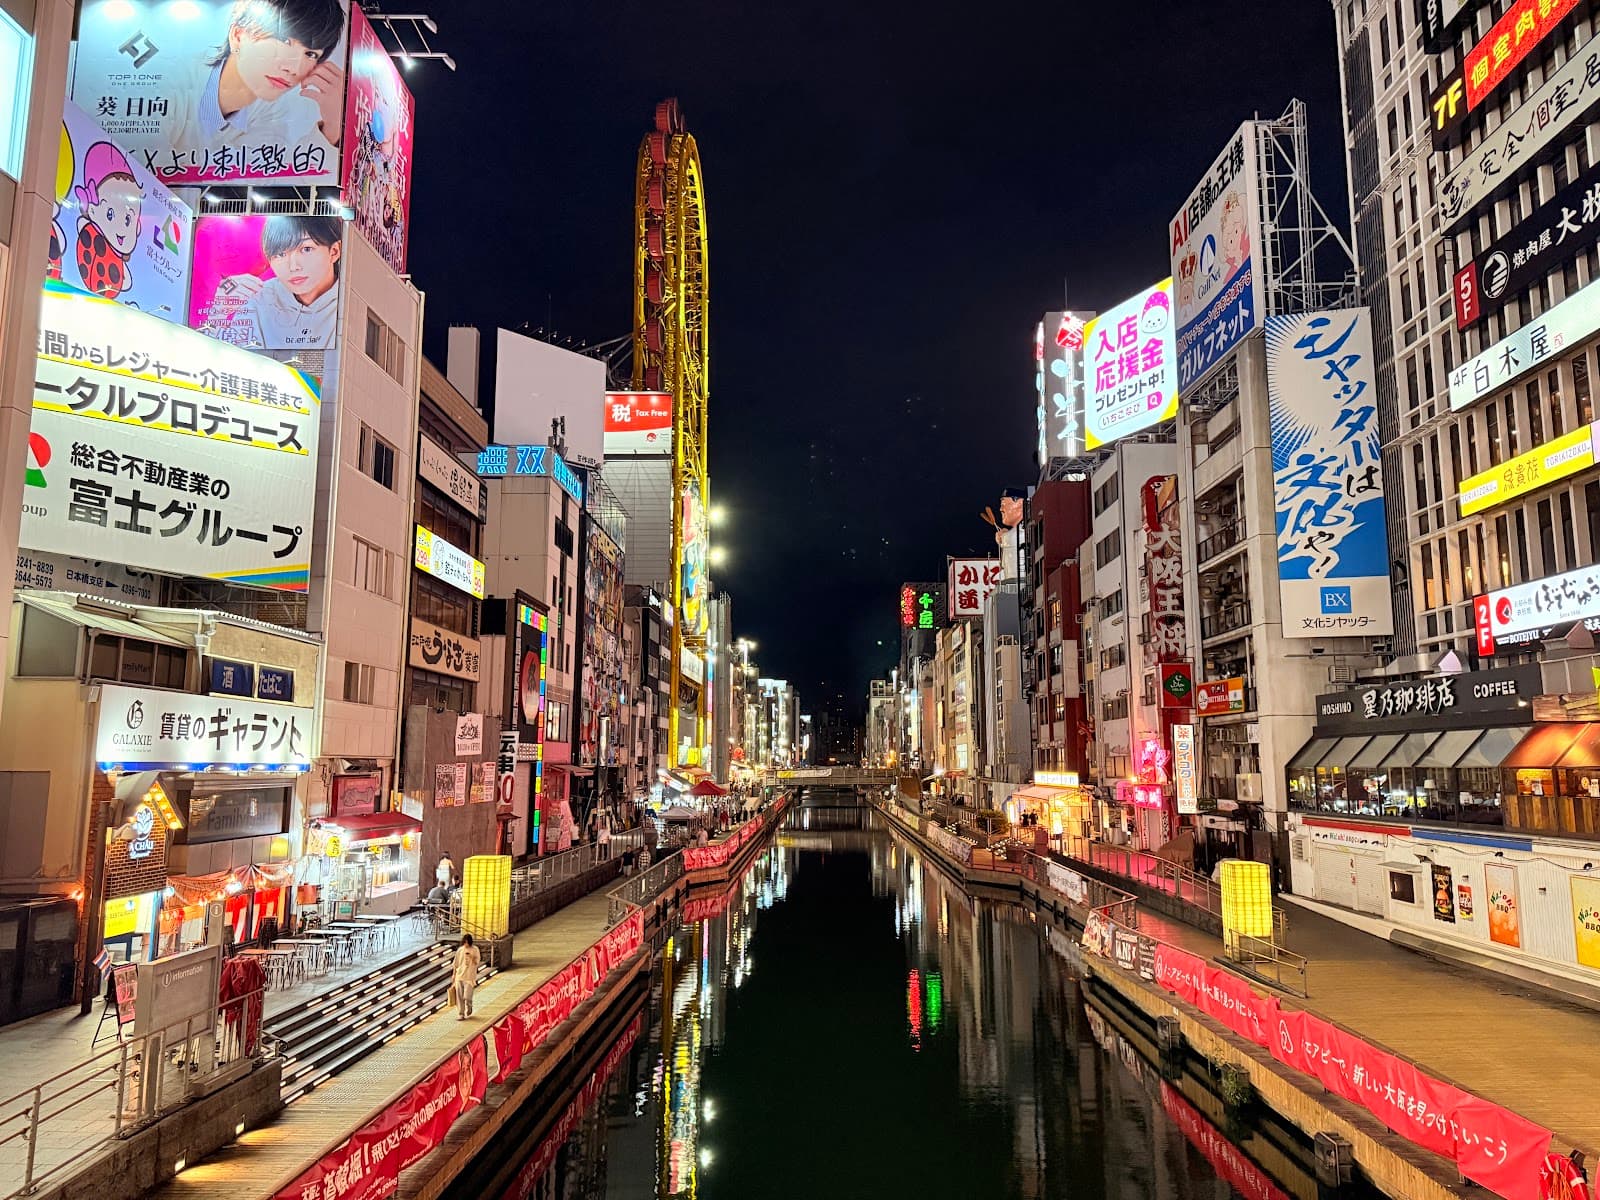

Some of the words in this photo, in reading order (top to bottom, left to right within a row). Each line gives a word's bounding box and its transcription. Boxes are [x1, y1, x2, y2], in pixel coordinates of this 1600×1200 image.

[126, 96, 169, 117] 日向
[1433, 78, 1462, 130] 7F
[1513, 228, 1553, 270] 焼肉屋
[1460, 271, 1472, 321] 5F
[1094, 314, 1139, 362] 入店
[1181, 300, 1250, 386] ガルフネット
[1095, 338, 1164, 394] 応援金
[1453, 368, 1468, 388] 4F
[1474, 324, 1552, 395] 白木屋
[611, 403, 632, 423] 税
[635, 409, 650, 418] Tax
[651, 409, 668, 418] Free
[70, 441, 231, 500] 総合不動産業の
[68, 477, 303, 560] 富士グループ
[957, 565, 1004, 586] かに
[957, 588, 993, 610] 道
[1324, 594, 1348, 607] BX
[1479, 604, 1490, 648] 2F
[222, 665, 235, 690] 酒
[259, 671, 283, 696] たばこ
[1473, 680, 1517, 698] COFFEE
[1321, 702, 1352, 716] HOSHINO
[1361, 677, 1456, 719] 星乃珈琲店
[112, 733, 153, 746] GALAXIE
[1495, 903, 1509, 914] BBQ
